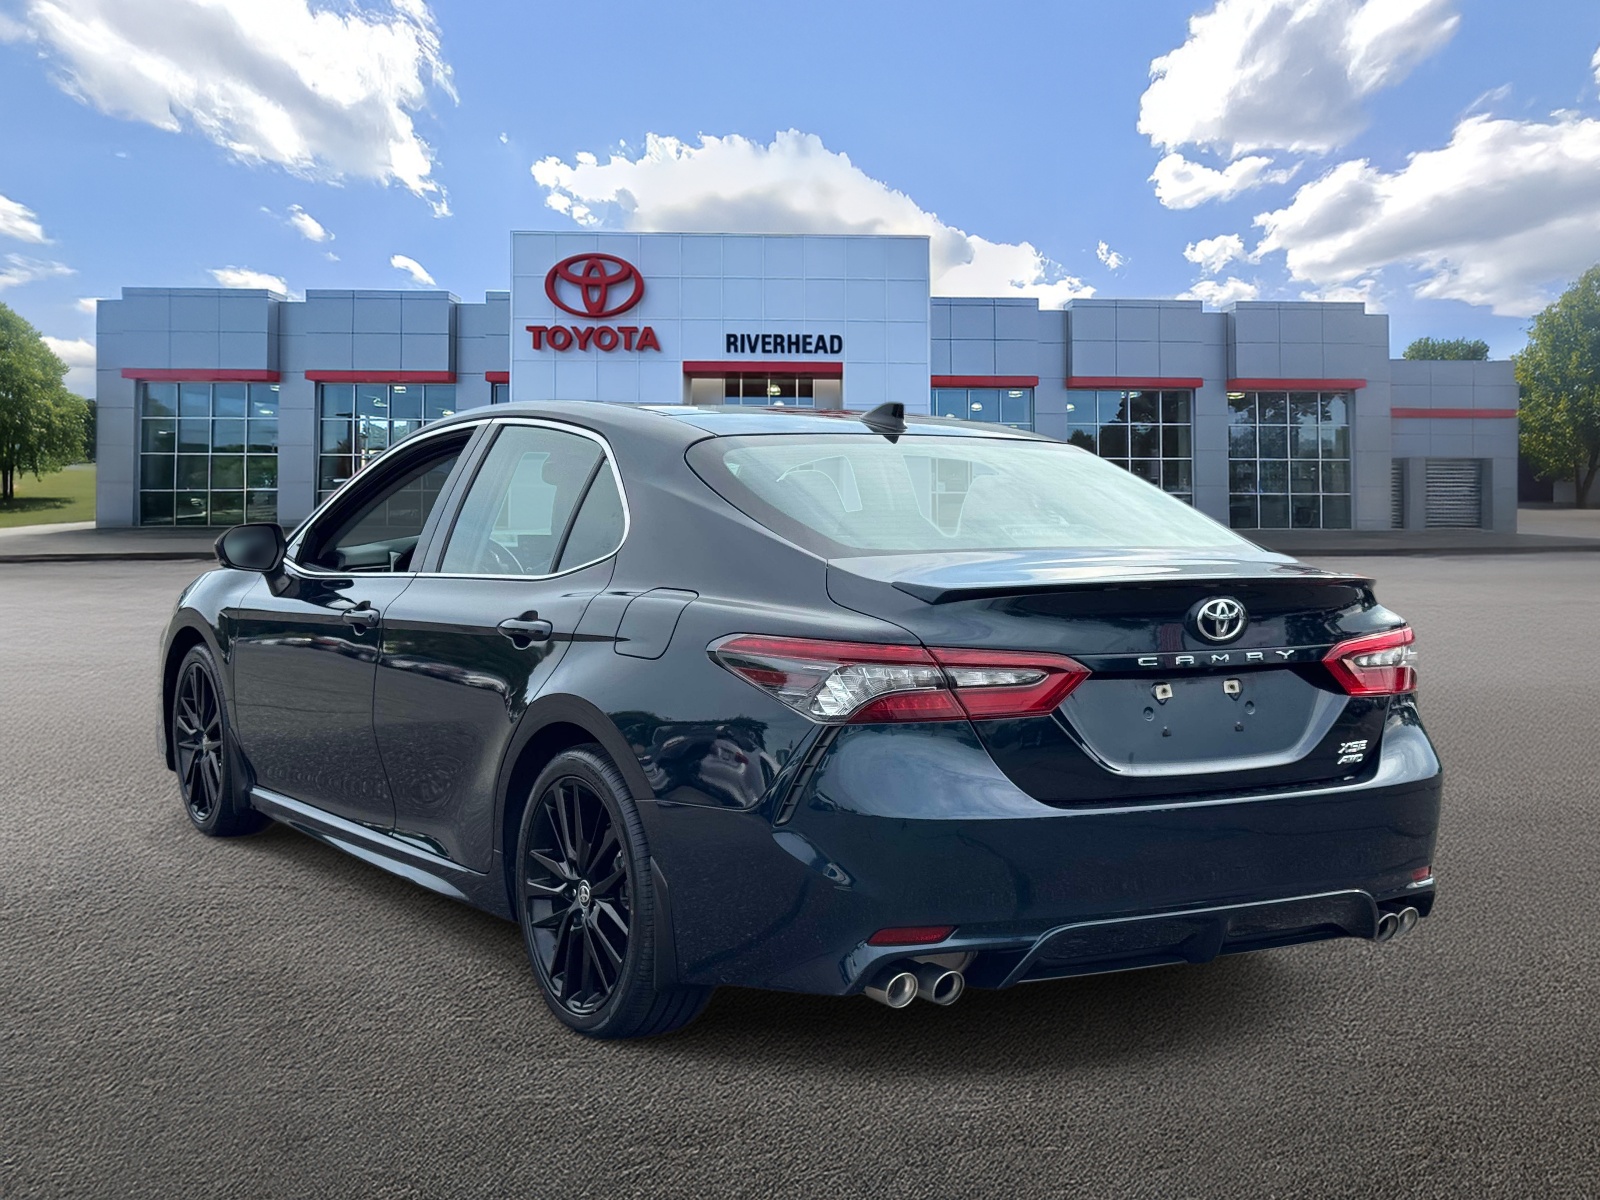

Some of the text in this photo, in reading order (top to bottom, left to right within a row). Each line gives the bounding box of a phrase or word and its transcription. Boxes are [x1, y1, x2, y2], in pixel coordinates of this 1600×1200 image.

[526, 326, 661, 352] TOYOTA
[726, 333, 843, 354] RIVERHEAD
[1138, 650, 1295, 666] CAMRY
